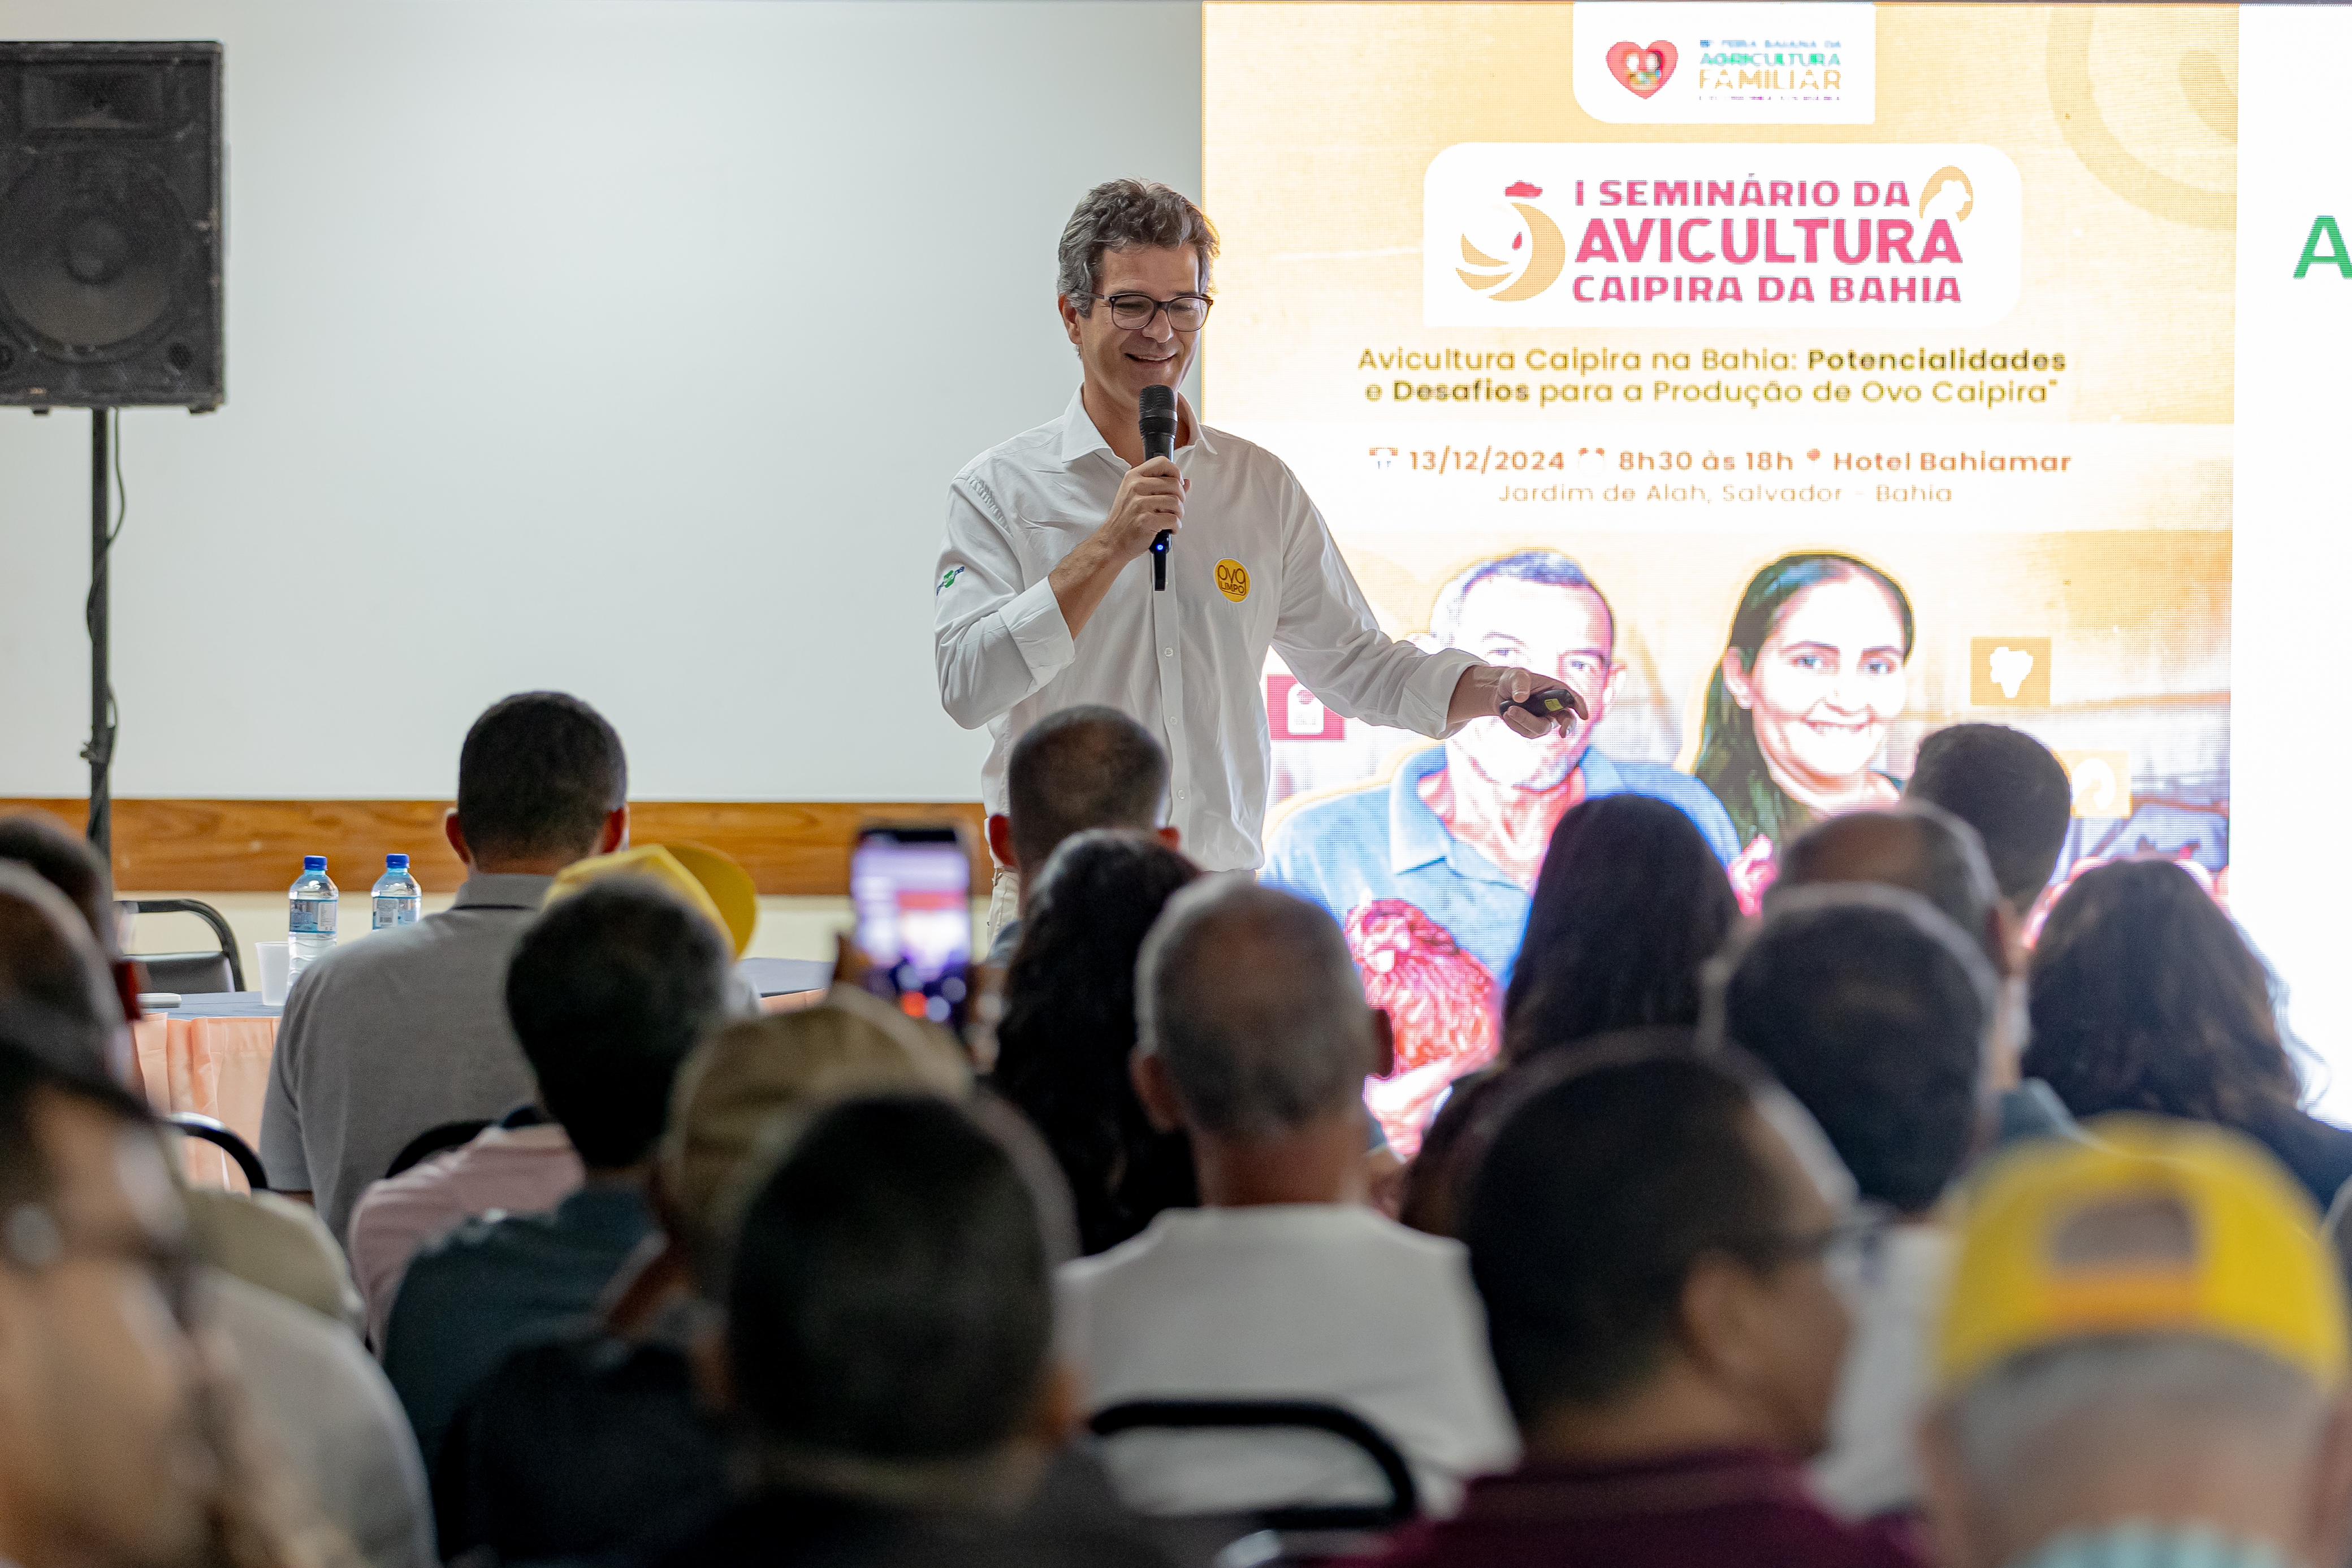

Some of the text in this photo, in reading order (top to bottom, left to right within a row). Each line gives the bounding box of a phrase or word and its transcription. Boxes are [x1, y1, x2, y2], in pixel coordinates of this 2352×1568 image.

[1700, 69, 1841, 89] FAMILIAR
[1575, 173, 1910, 207] I SEMINÁRIO DA
[1574, 217, 1963, 264] AVICULTURA
[1572, 275, 1963, 304] CAIPIRA DA BAHIA
[1357, 346, 2068, 377] Avicultura Caipira na Bahia: Potencialidades
[1364, 383, 1384, 403] e
[1391, 377, 1532, 403] Desafios
[1539, 382, 1614, 410] para
[1622, 383, 1644, 404] a
[1653, 379, 1804, 410] Produção
[1811, 379, 1852, 404] de
[1861, 380, 1923, 404] Ovo
[1410, 445, 2073, 475] 13/12/2024 8h30 às 18h Hotel Bahiamar
[1499, 484, 1594, 503] Jardim
[1602, 484, 1636, 503] de
[1646, 484, 1711, 505] Alah,
[1723, 484, 1842, 503] Salvador
[1875, 483, 1953, 503] Bahia
[1218, 565, 1246, 584] OVO
